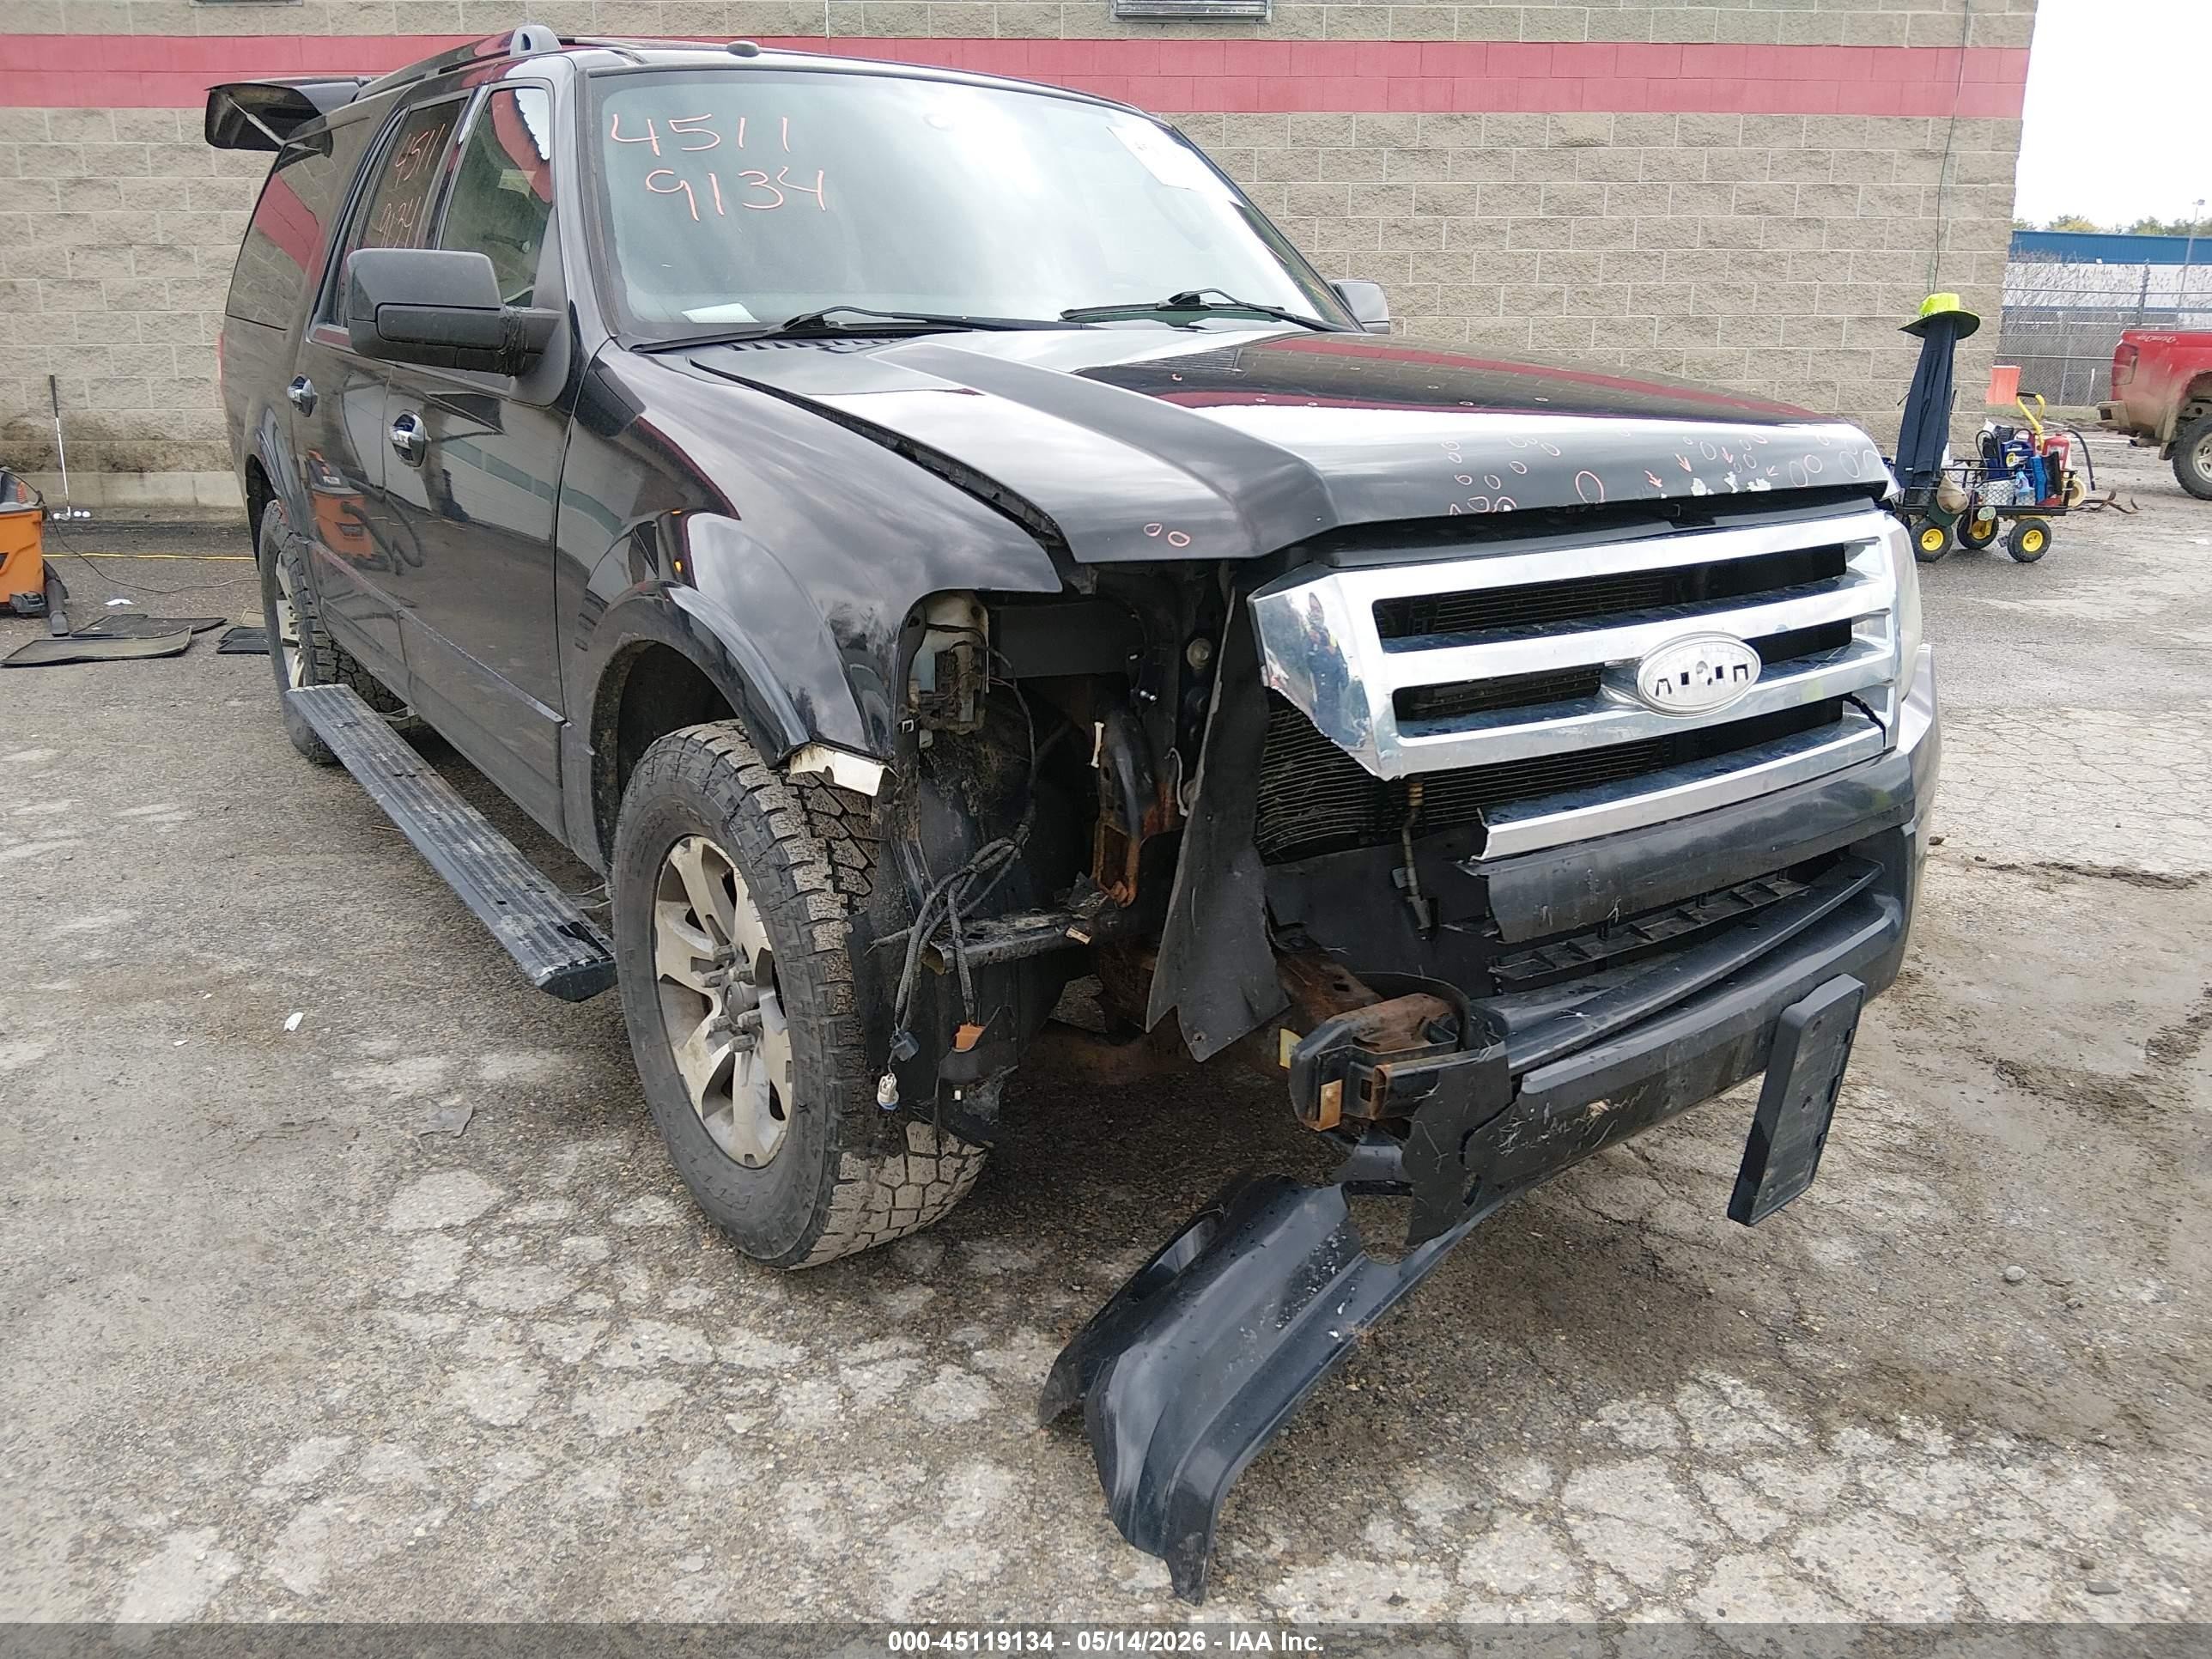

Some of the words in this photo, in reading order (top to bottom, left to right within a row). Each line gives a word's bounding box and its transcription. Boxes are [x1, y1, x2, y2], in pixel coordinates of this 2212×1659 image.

[396, 124, 446, 187] 4511
[611, 113, 790, 157] 4511
[646, 166, 826, 222] 9134
